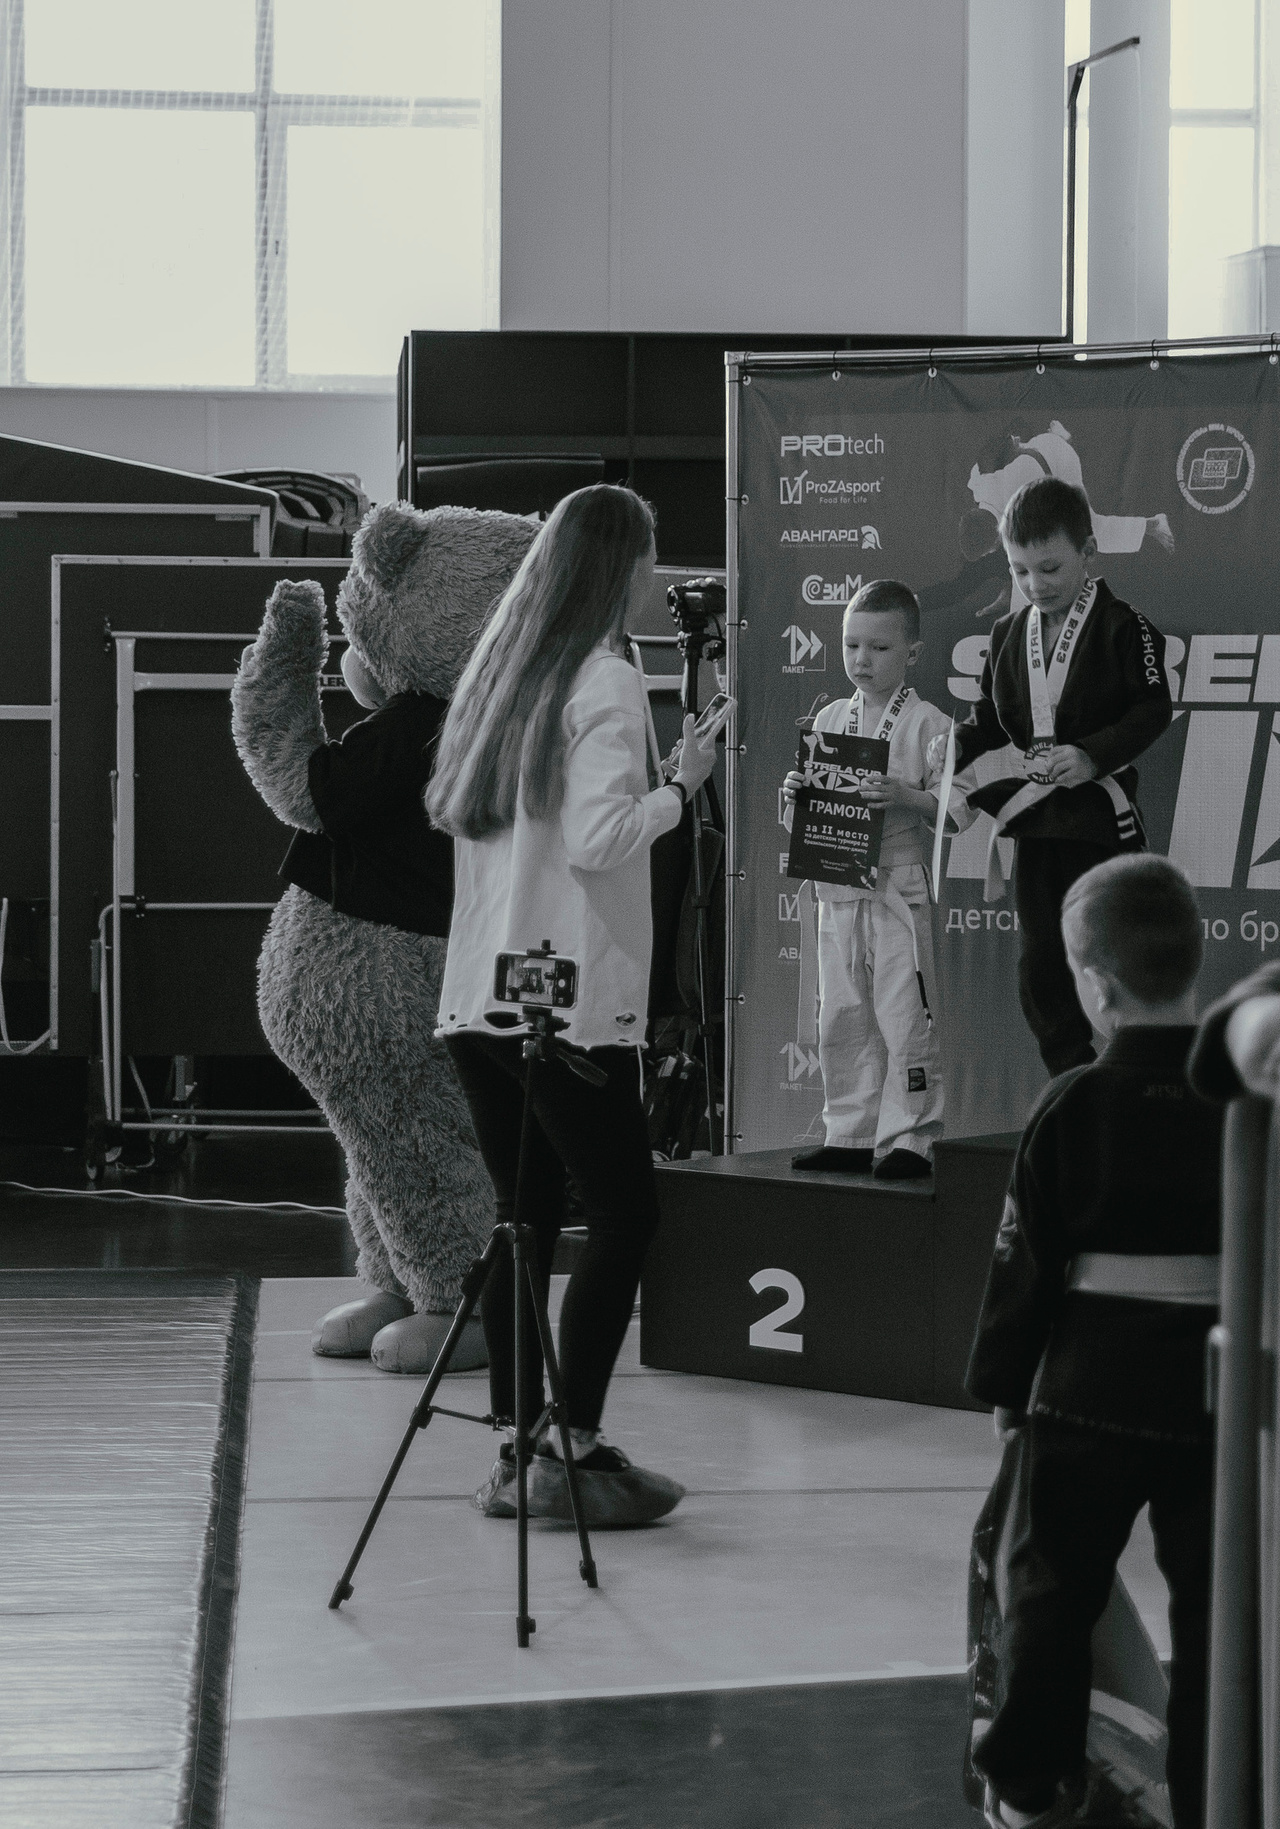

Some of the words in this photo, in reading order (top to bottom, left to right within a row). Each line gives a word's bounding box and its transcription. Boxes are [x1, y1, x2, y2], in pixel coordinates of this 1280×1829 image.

[780, 433, 884, 457] PROtech
[806, 480, 881, 496] ProZAsport
[780, 529, 858, 542] АВАНГАРД
[782, 666, 805, 674] ПАКЕТ
[803, 760, 853, 774] STRELA
[809, 799, 871, 821] ГРАМОТА
[805, 824, 818, 833] за
[821, 825, 833, 835] II
[836, 829, 870, 841] место
[749, 1268, 806, 1353] 2
